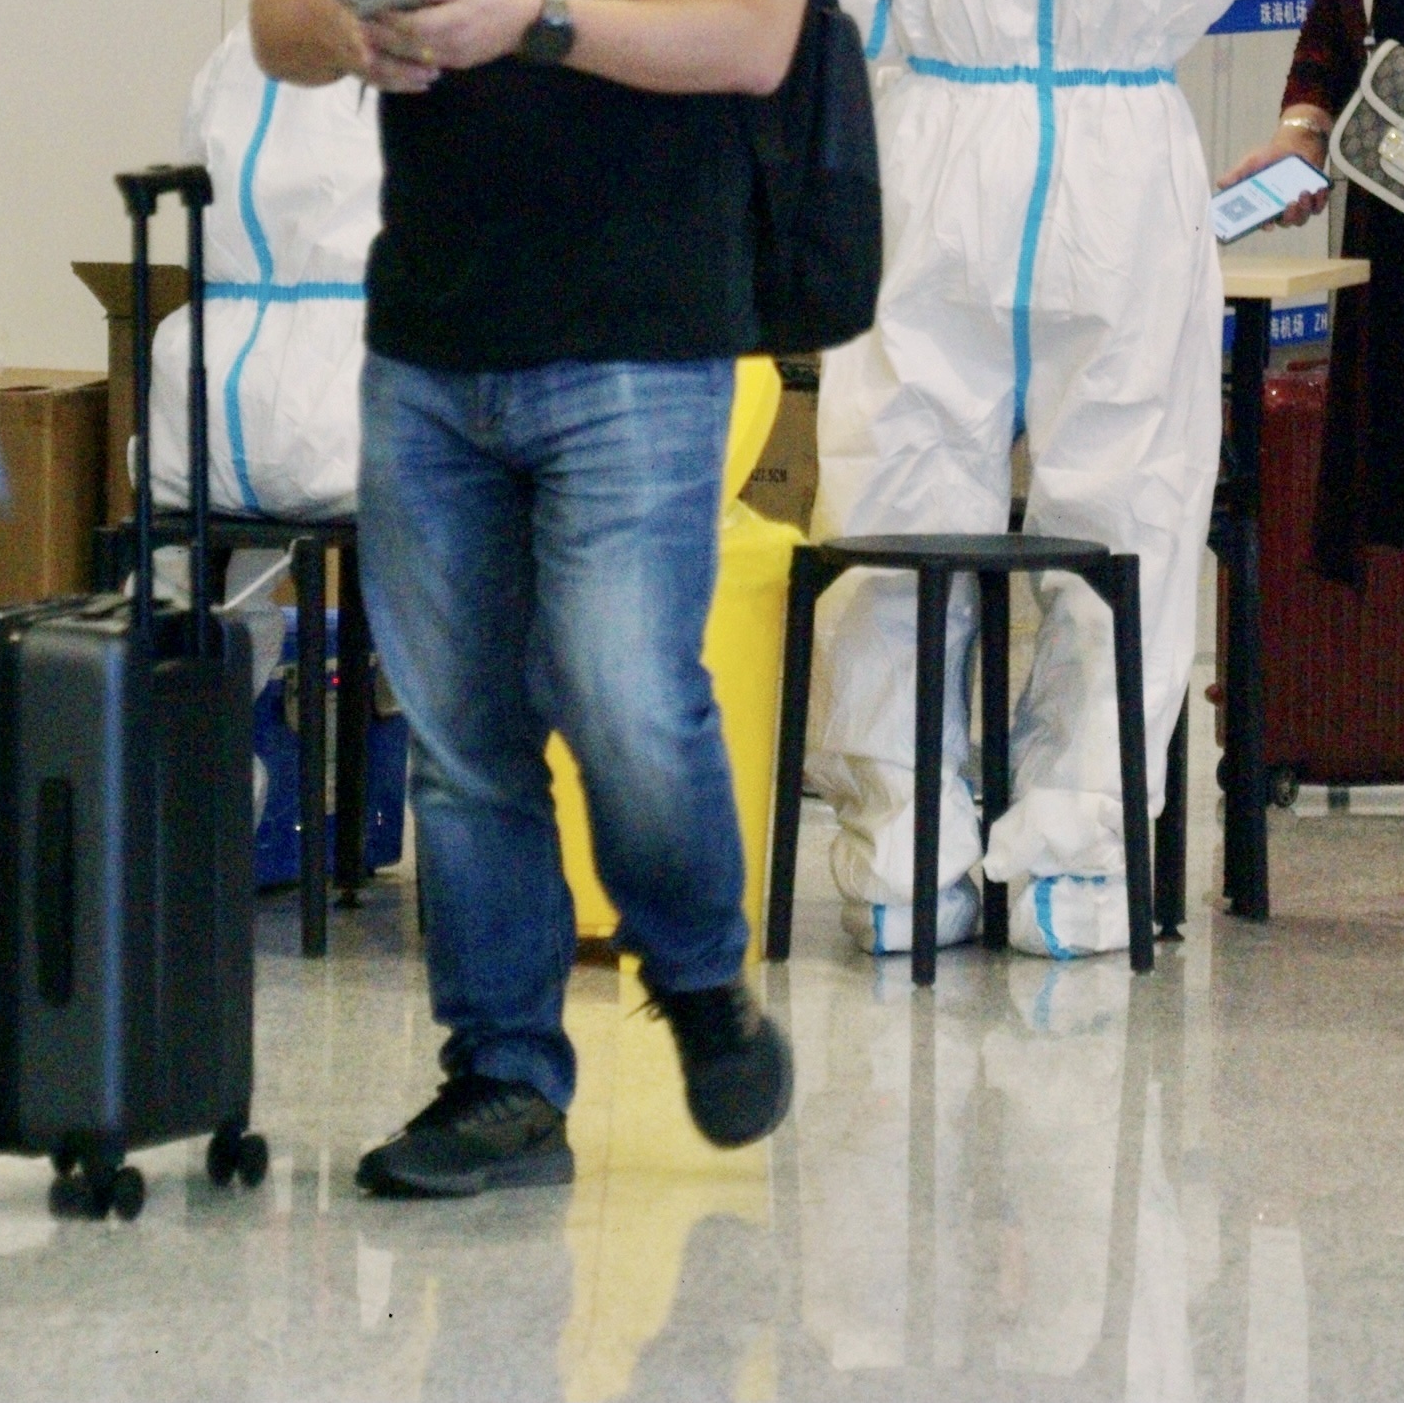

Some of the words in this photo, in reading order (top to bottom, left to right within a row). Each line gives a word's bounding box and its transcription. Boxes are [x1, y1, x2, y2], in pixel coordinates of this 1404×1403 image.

[1260, 0, 1307, 24] 珠海机场
[1271, 314, 1304, 340] 海机场
